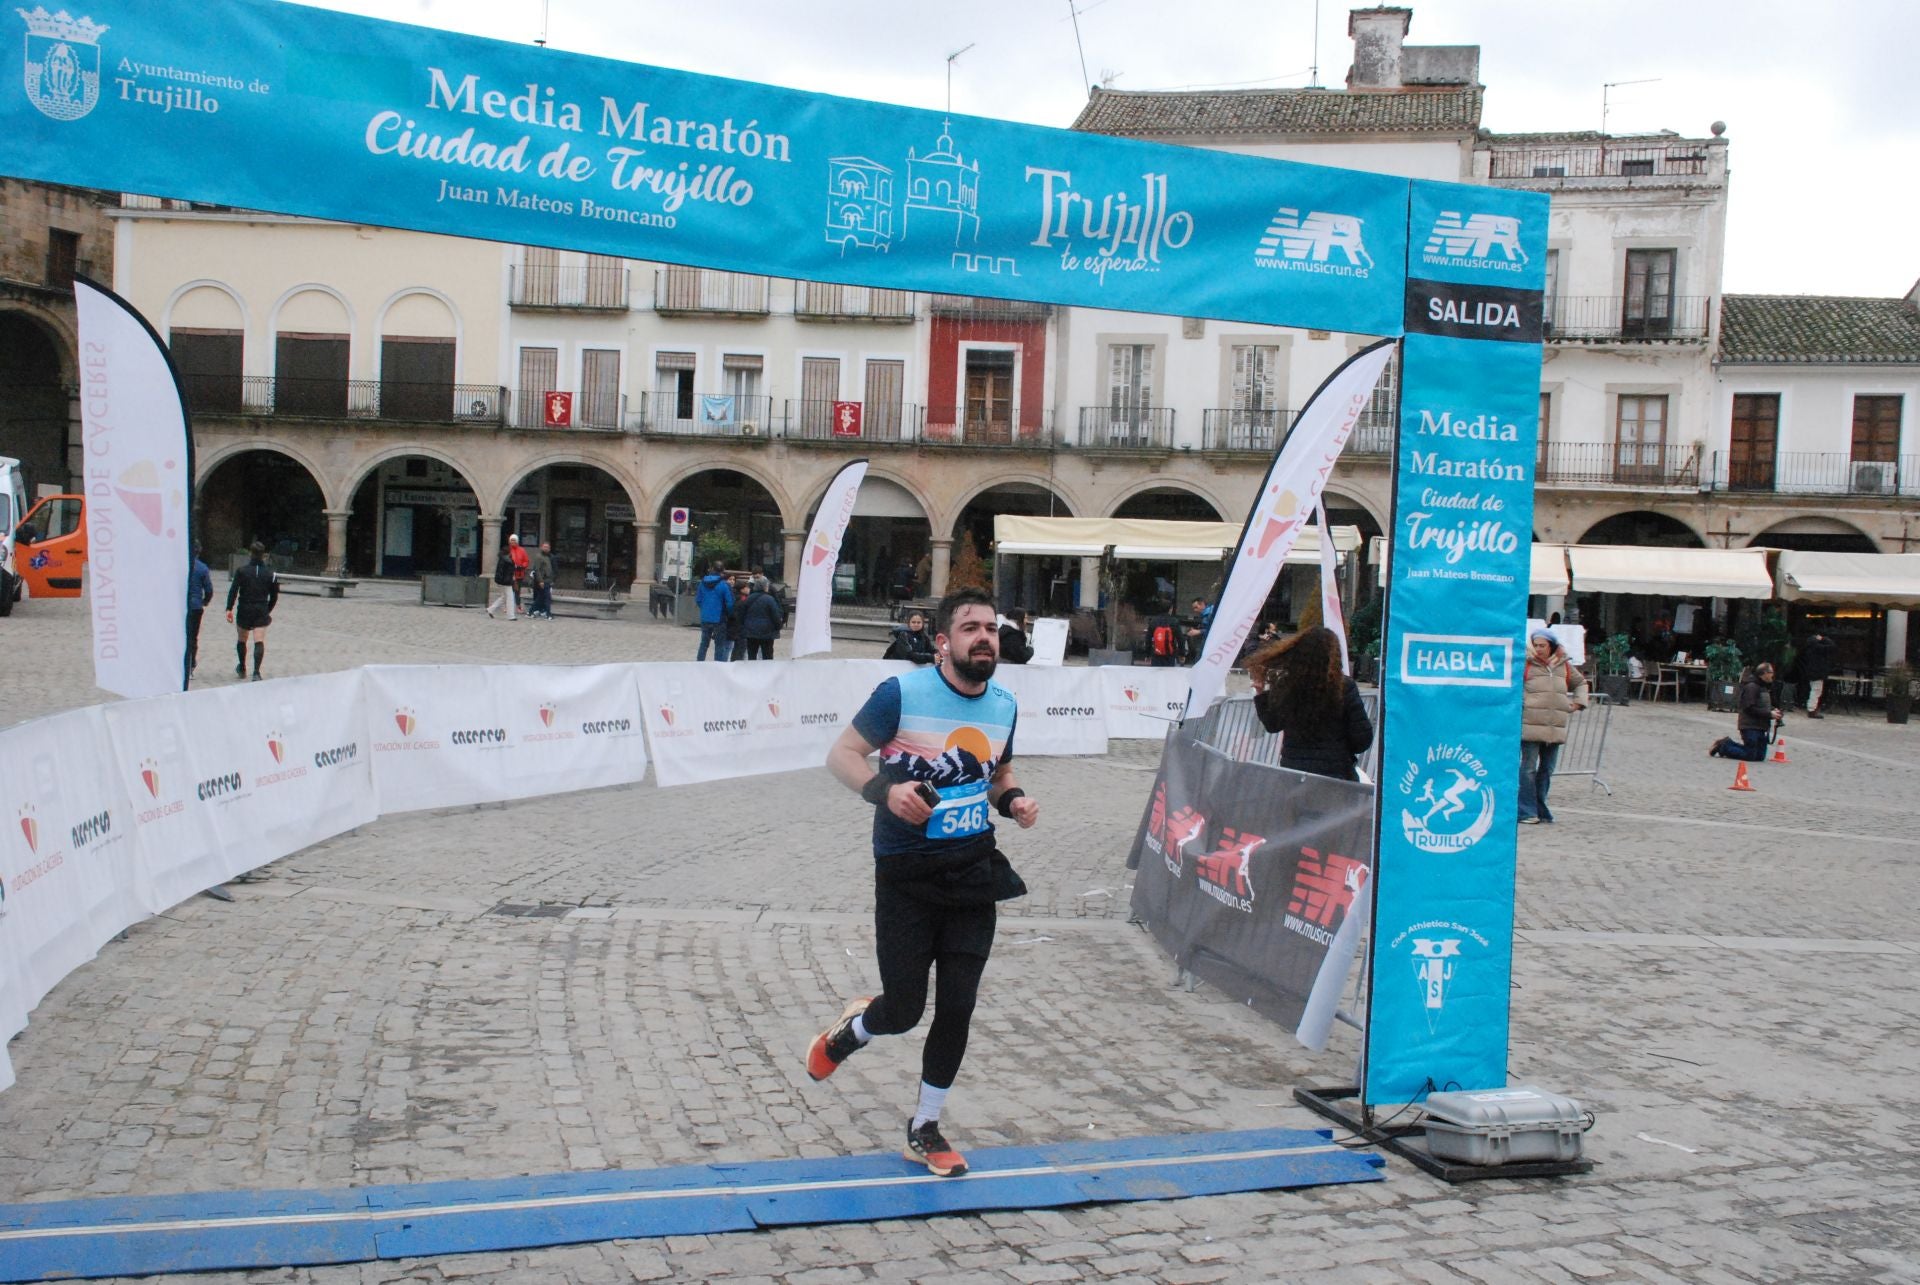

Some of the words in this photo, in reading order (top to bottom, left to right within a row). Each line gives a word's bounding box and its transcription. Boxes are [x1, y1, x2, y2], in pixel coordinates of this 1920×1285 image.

[117, 57, 244, 91] Ayuntamiento
[249, 78, 270, 95] de
[115, 78, 219, 114] Trujillo
[425, 67, 583, 133] Media
[598, 96, 791, 162] Maratón
[365, 110, 532, 174] Ciudad
[538, 142, 597, 182] de
[606, 147, 754, 212] Trujillo
[437, 179, 489, 204] Juan
[496, 187, 573, 215] Mateos
[580, 199, 677, 229] Broncano
[1025, 165, 1194, 263] Trujillo
[1061, 243, 1079, 271] te
[1254, 257, 1369, 279] www.musicrun.es
[1422, 253, 1522, 272] www.musicrun.es
[1428, 297, 1520, 328] SALIDA
[1417, 410, 1519, 442] Media
[1410, 451, 1525, 481] Maratón
[1421, 487, 1480, 510] Ciudad
[1482, 494, 1504, 511] de
[1405, 511, 1518, 564] Trujillo
[1406, 567, 1430, 579] Juan
[1432, 568, 1469, 580] Mateos
[1470, 570, 1514, 583] Broncano
[1417, 649, 1495, 672] HABLA
[1400, 760, 1419, 794] Club
[1427, 743, 1488, 777] Atletismo
[942, 805, 982, 834] 546
[1408, 828, 1473, 847] TRUJILLO
[1199, 878, 1252, 913] www.musicrun.es
[1391, 932, 1407, 948] Club
[1408, 920, 1450, 934] Athletico
[1451, 923, 1469, 933] San
[1469, 929, 1489, 947] José
[1418, 963, 1428, 980] A
[1444, 962, 1452, 980] J
[1431, 981, 1439, 998] S
